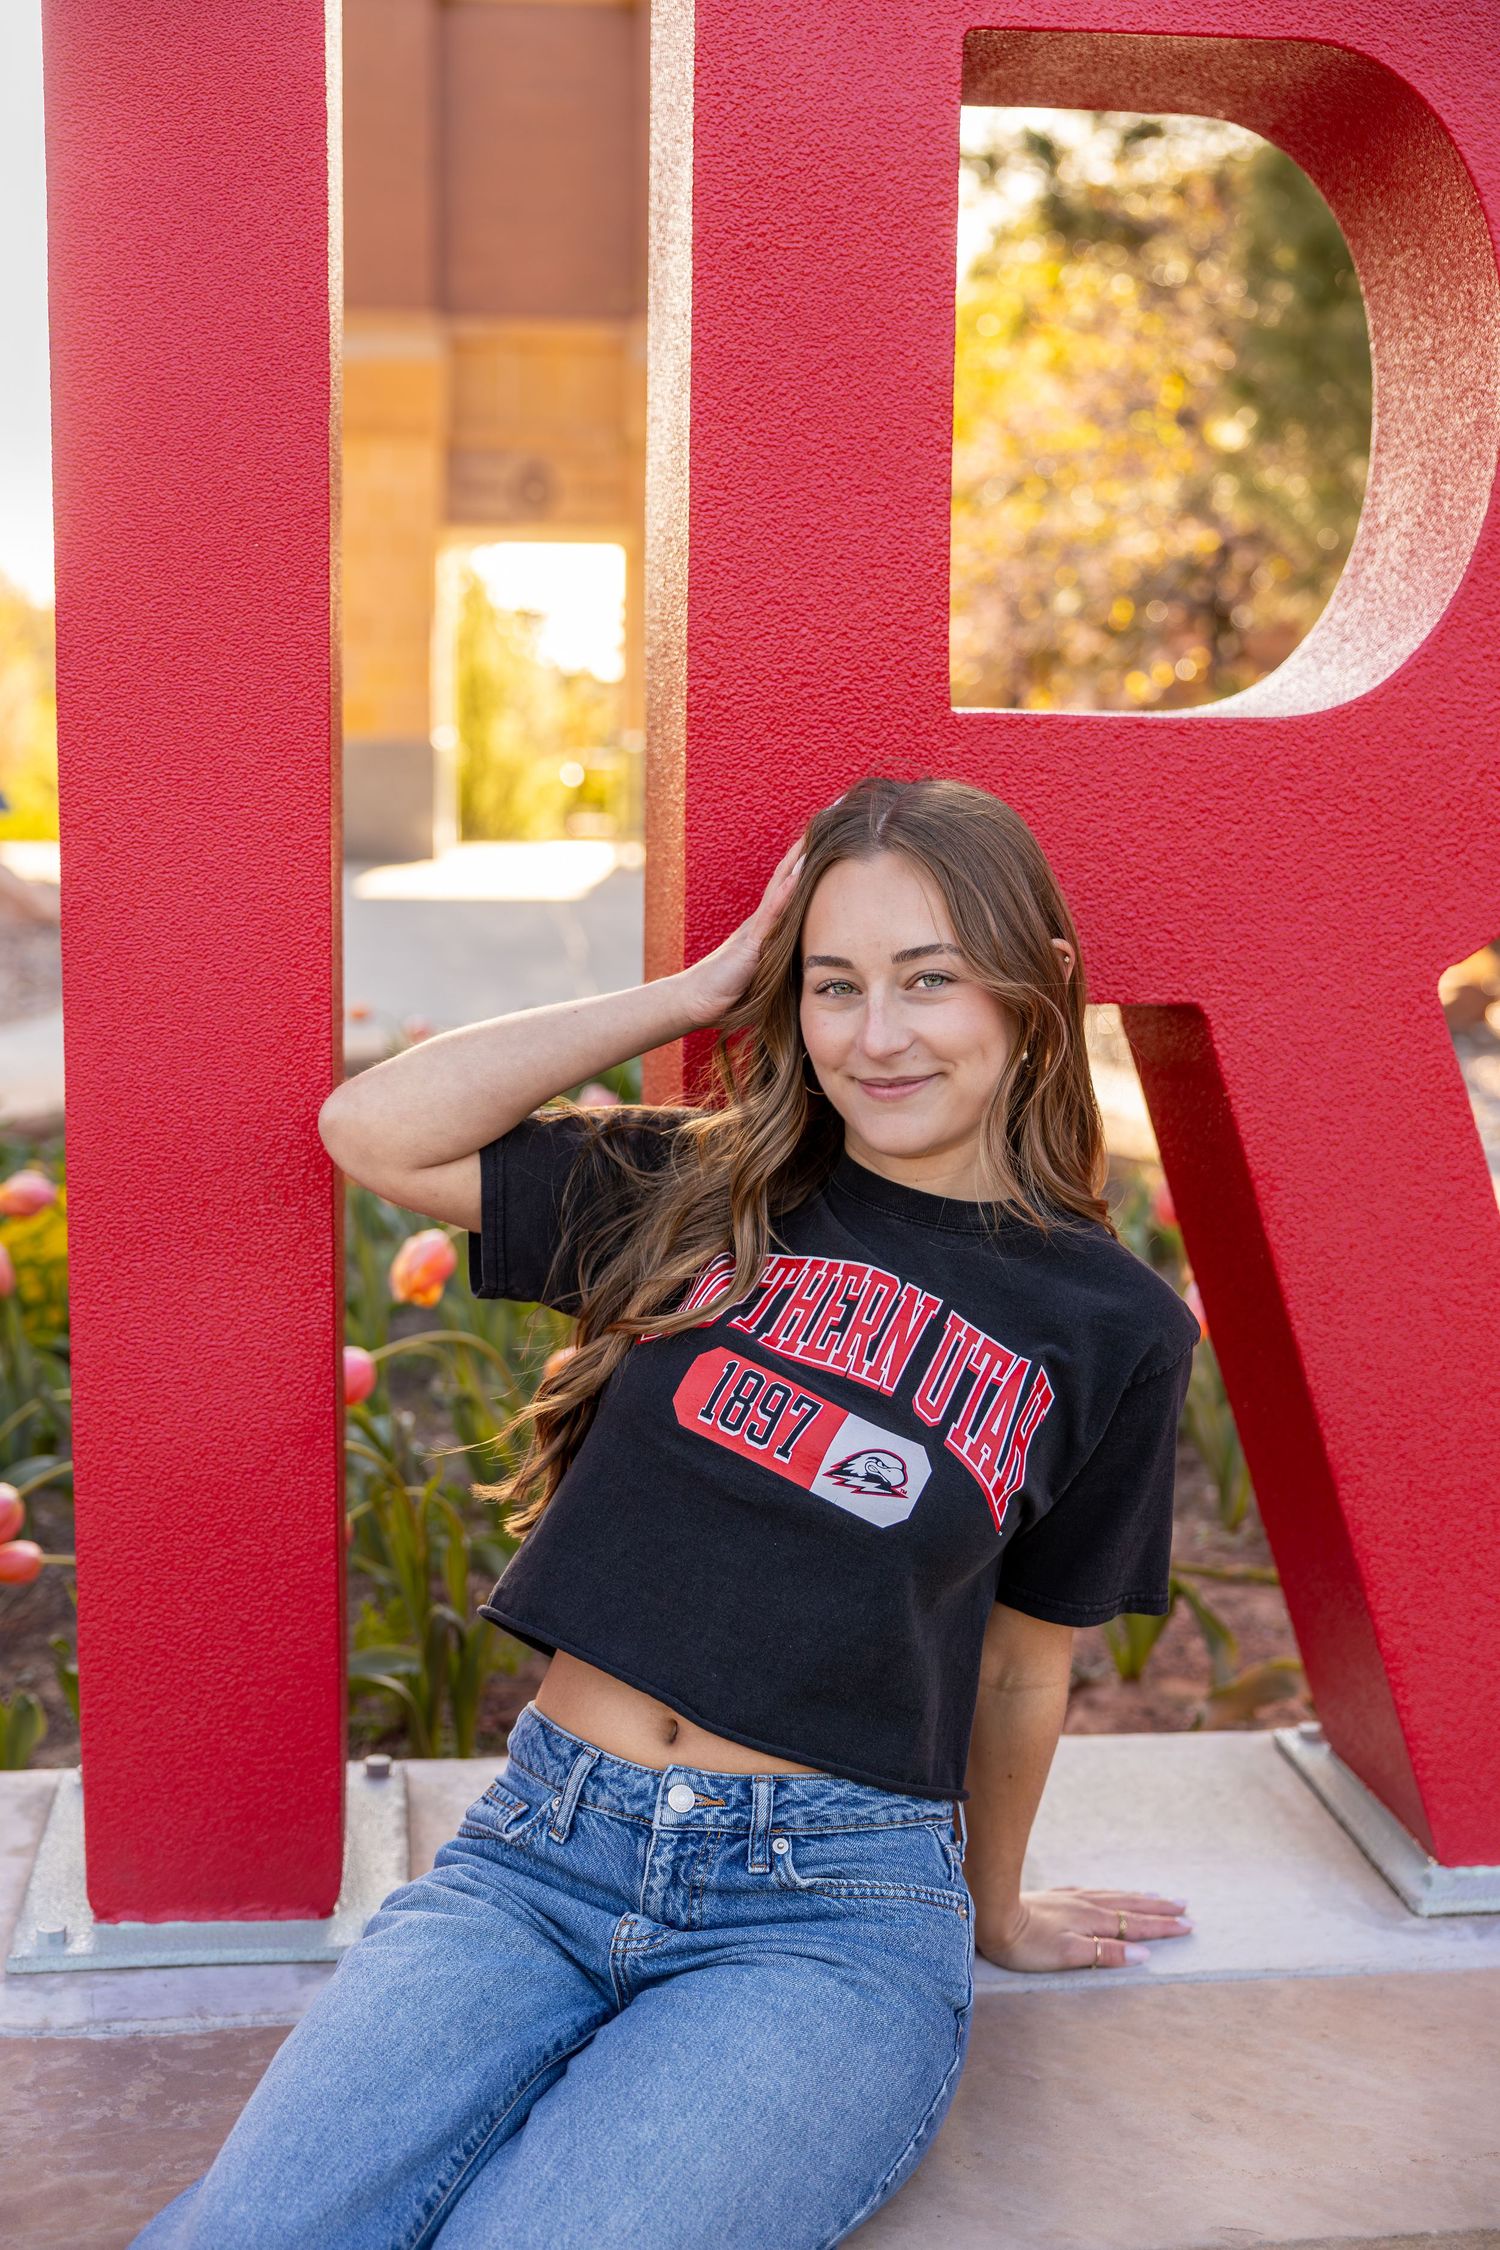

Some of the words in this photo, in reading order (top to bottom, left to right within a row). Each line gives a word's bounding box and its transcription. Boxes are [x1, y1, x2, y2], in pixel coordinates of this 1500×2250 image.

[636, 1251, 943, 1397] THERN
[912, 1309, 1055, 1534] UTAH
[697, 1359, 824, 1465] 1897
